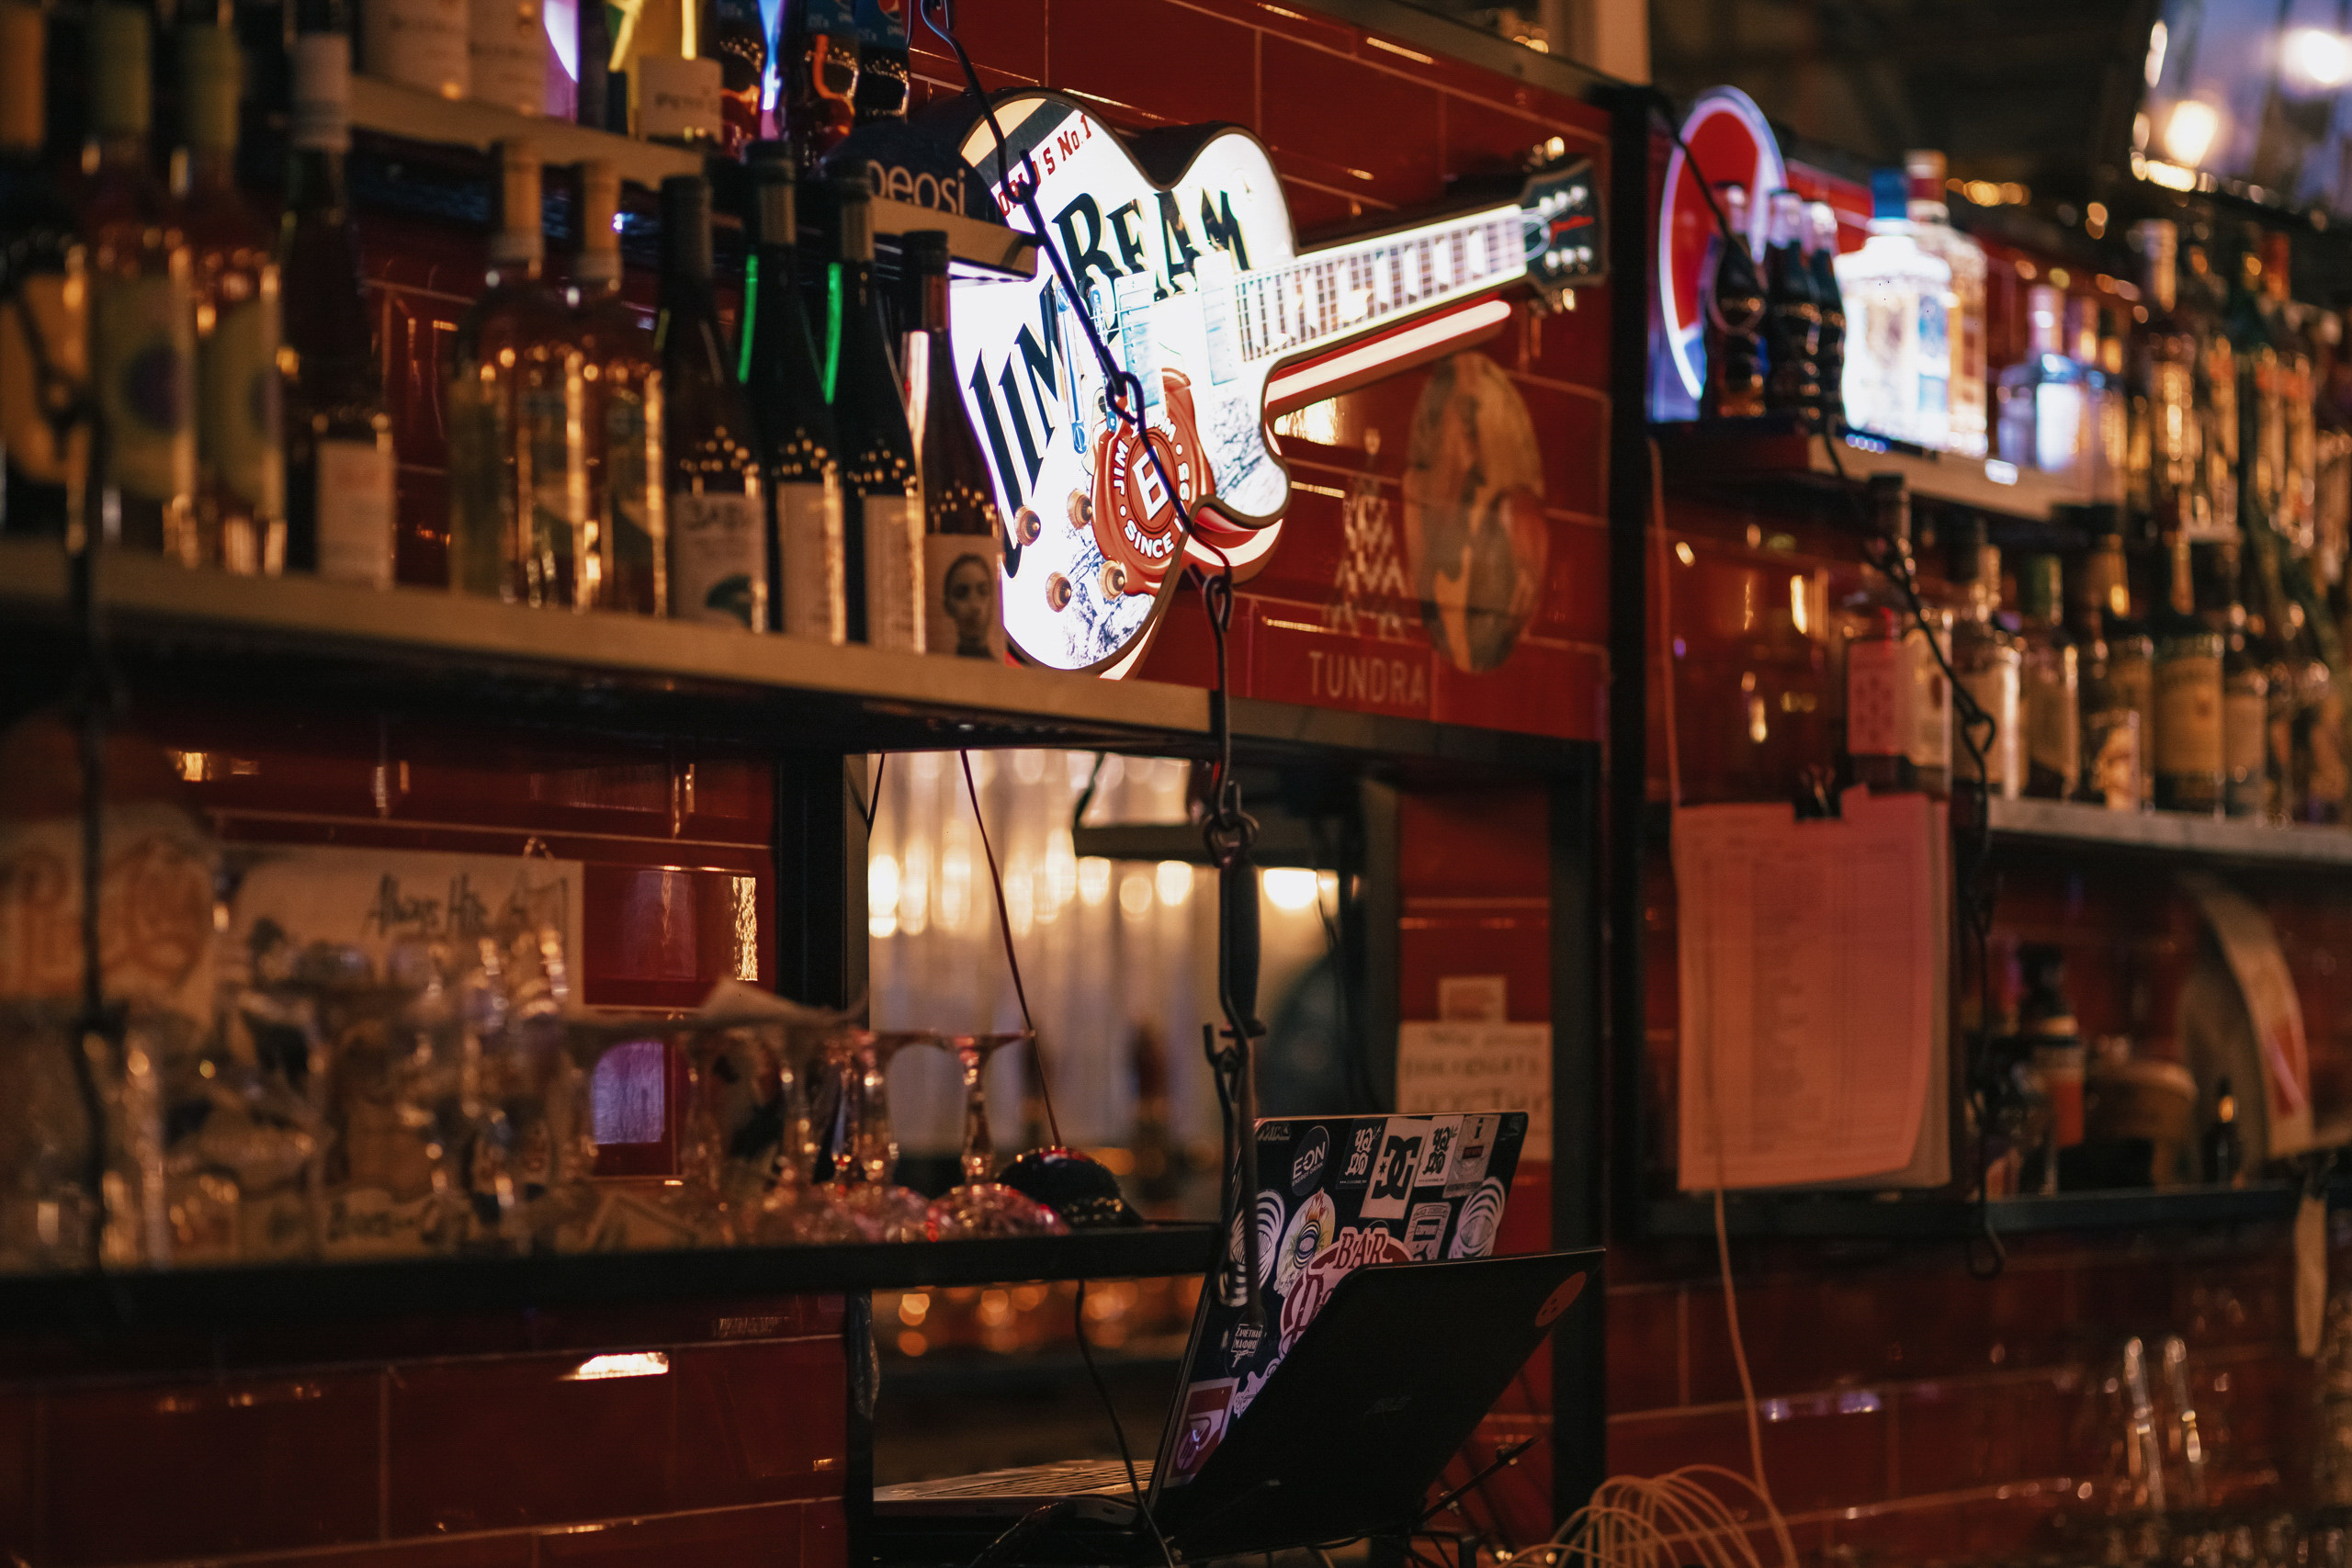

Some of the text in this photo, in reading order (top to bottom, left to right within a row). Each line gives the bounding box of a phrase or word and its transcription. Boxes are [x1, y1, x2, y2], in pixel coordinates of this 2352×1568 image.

[1080, 113, 1091, 140] 1
[969, 188, 1250, 579] JIM BEAM
[1114, 439, 1129, 496] JIM
[1124, 519, 1175, 558] SINCE
[1309, 651, 1425, 704] TUNDRA
[1292, 1140, 1326, 1179] EON
[1333, 1232, 1388, 1269] BAR
